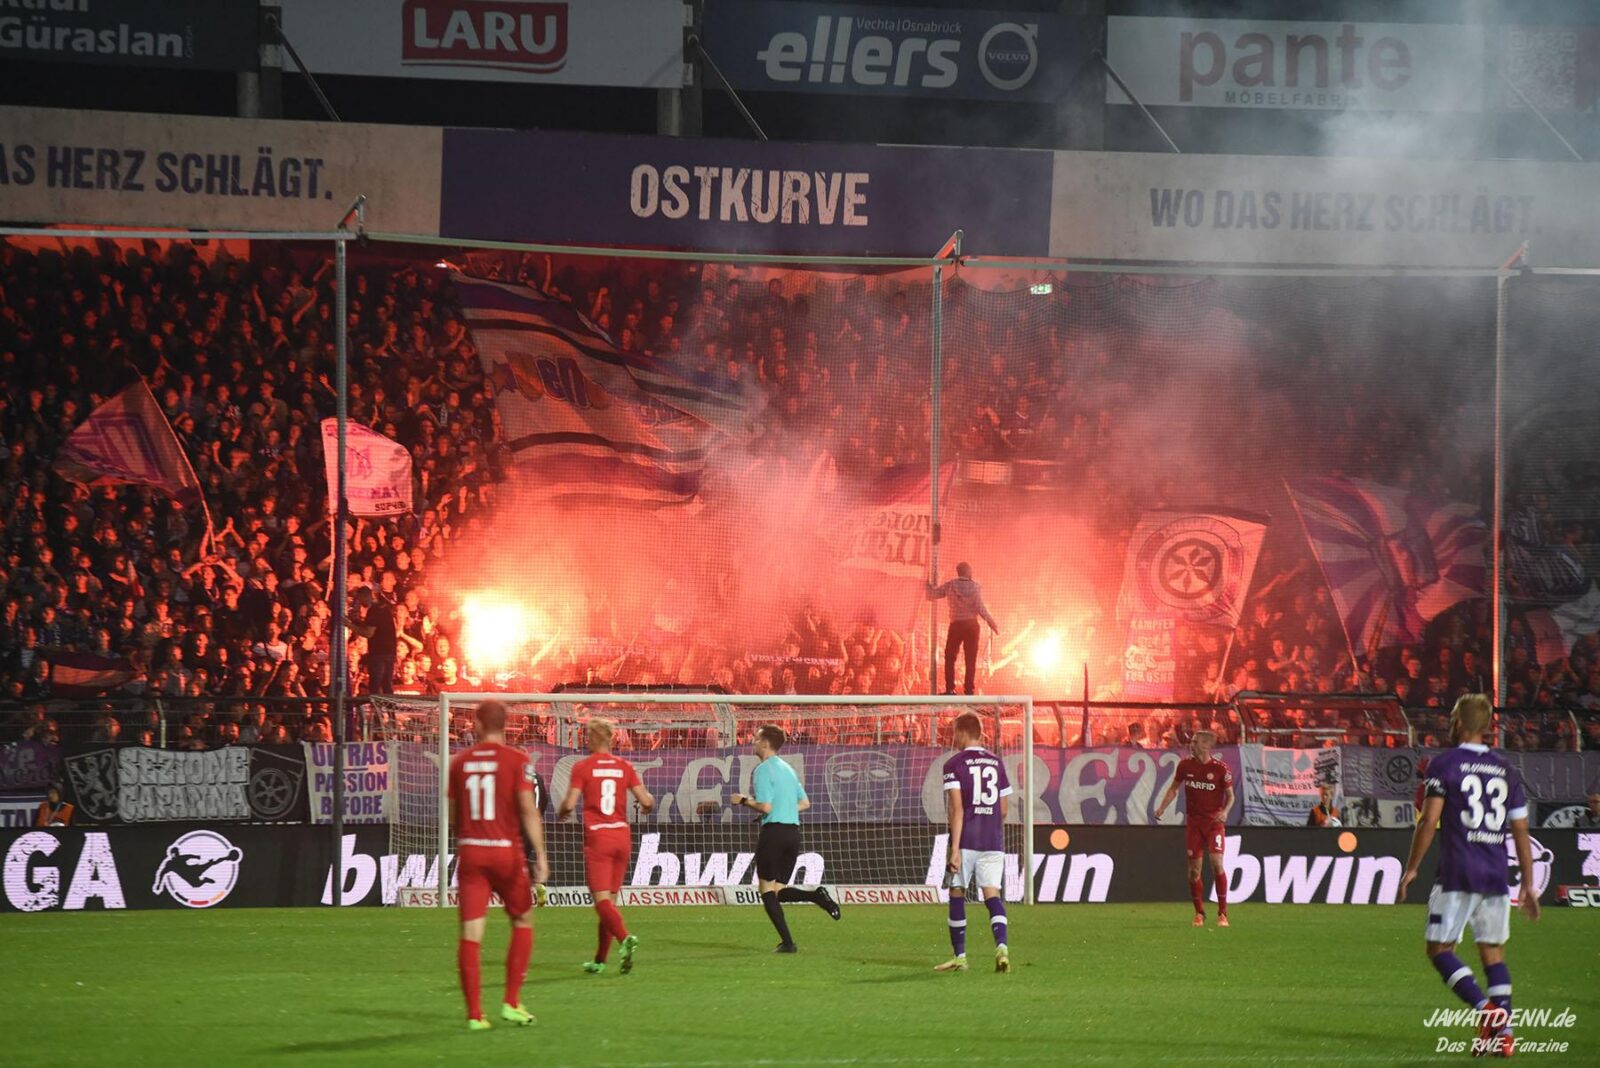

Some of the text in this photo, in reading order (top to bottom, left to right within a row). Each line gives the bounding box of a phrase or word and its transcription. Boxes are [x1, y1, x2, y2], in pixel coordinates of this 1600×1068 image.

[0, 16, 184, 57] Güraslan
[412, 6, 559, 55] LARU
[757, 16, 961, 89] ellers
[986, 50, 1029, 62] VOLVO
[1178, 24, 1412, 102] pante
[47, 145, 147, 192] HERZ
[155, 146, 333, 200] SCHLÄGT.
[629, 163, 870, 227] OSTKURVE
[1149, 187, 1204, 229] WO
[1212, 189, 1282, 231] DAS
[1290, 191, 1374, 233] HERZ
[314, 771, 388, 793] PASION
[320, 795, 383, 815] BFORE
[464, 773, 497, 822] 11
[599, 778, 618, 817] 8
[968, 765, 999, 806] 13
[1460, 774, 1510, 832] 33
[1209, 831, 1401, 906] bwin
[628, 890, 721, 906] ASSMANN
[843, 889, 934, 905] ASSMANN
